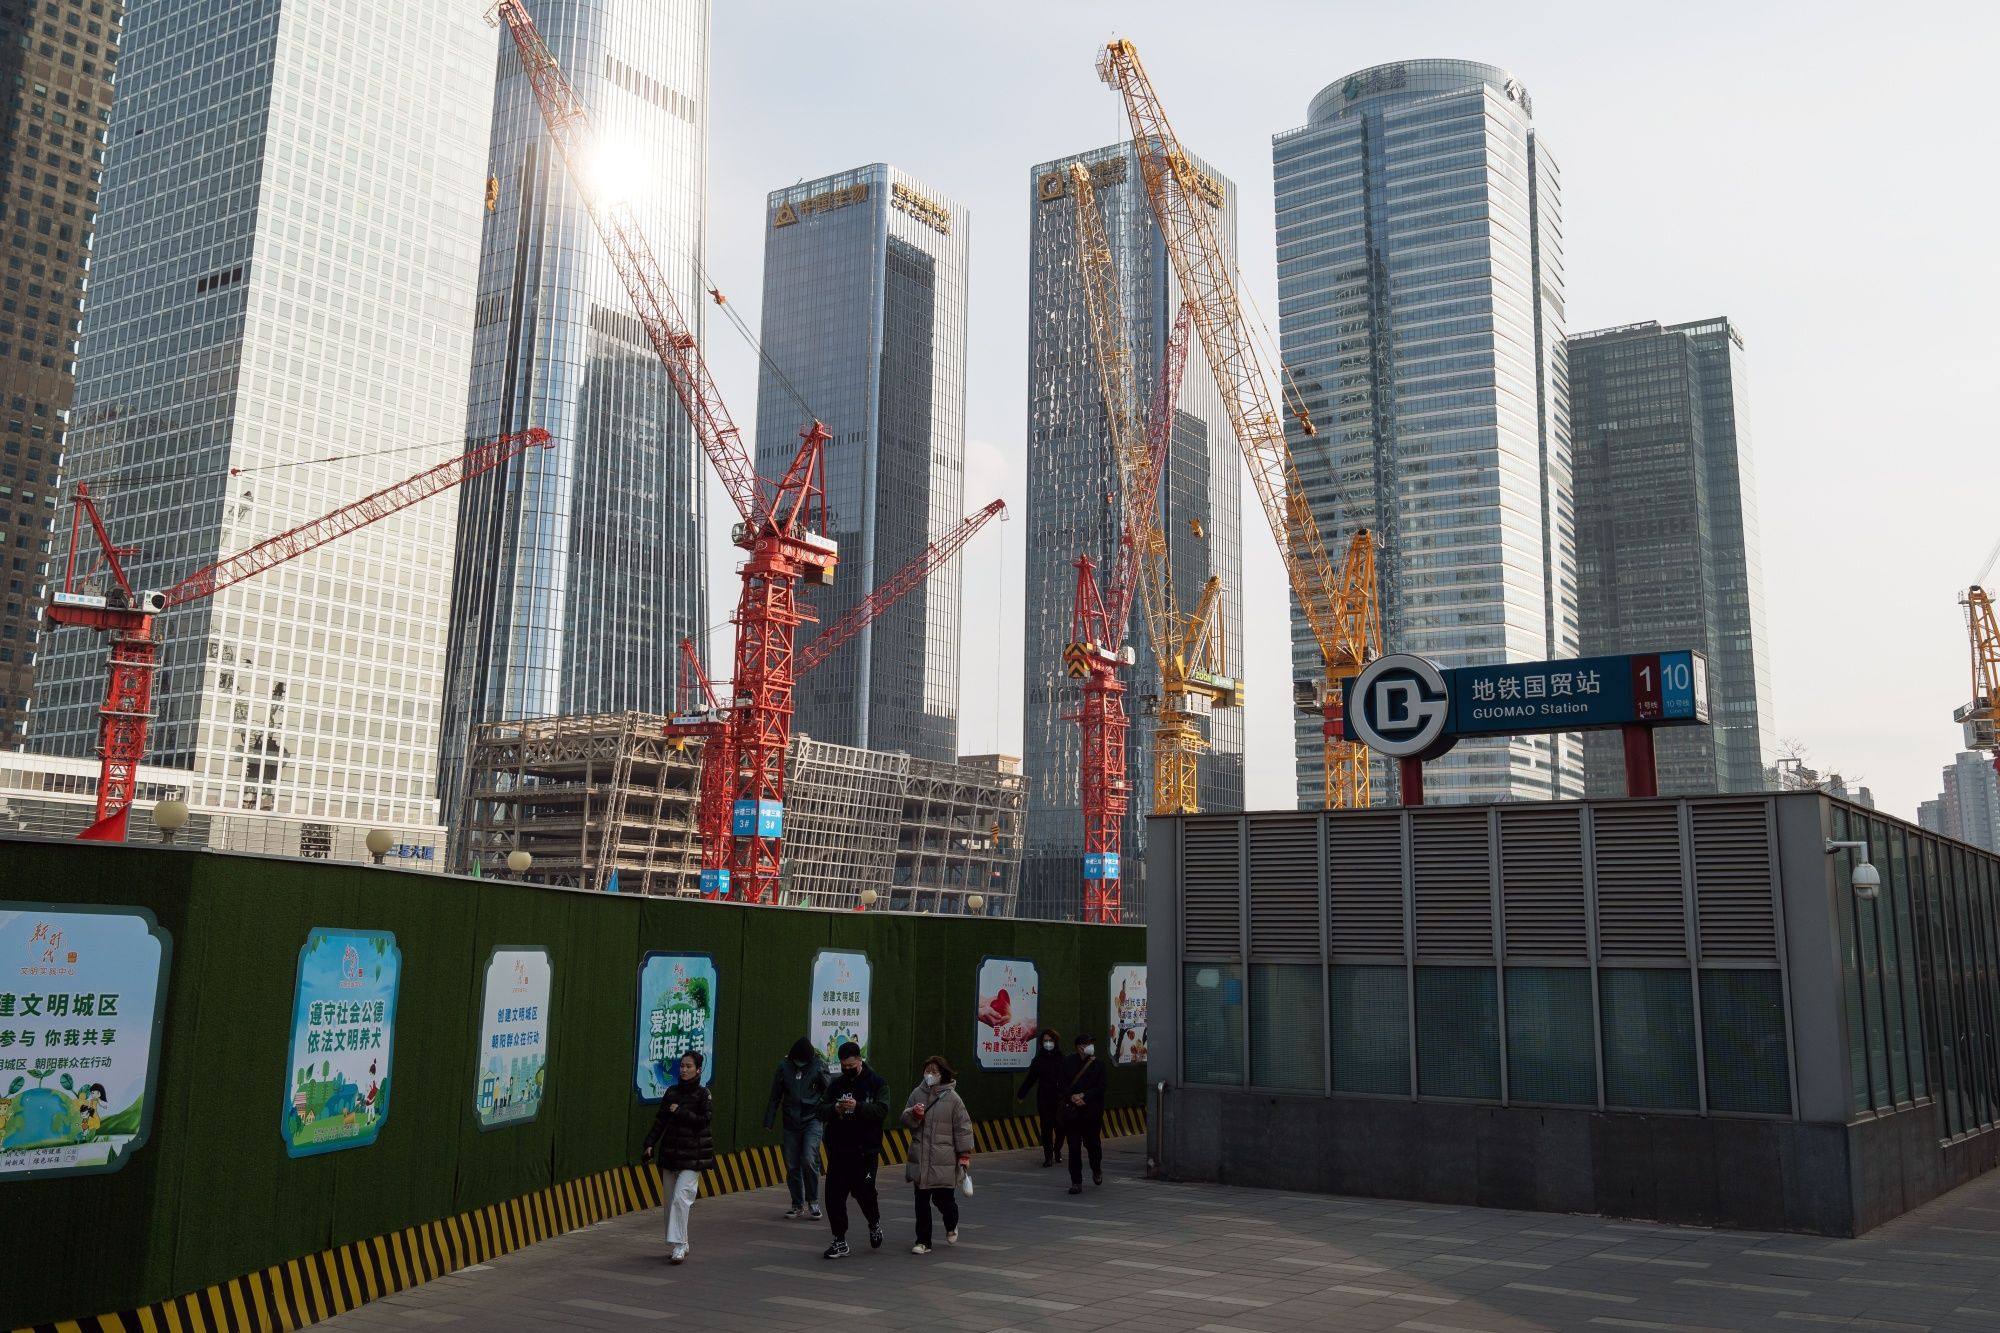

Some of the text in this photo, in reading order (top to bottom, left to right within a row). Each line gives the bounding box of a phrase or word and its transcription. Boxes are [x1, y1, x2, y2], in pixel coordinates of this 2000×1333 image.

[1472, 670, 1601, 702] 地铁国贸站
[1639, 665, 1652, 692] 1
[1663, 663, 1689, 690] 10
[1473, 702, 1588, 720] GUOMAO Station
[740, 819, 750, 828] 3#
[822, 990, 861, 1003] 创建文明城区
[309, 1001, 384, 1026] 遵守社会公德
[497, 1006, 538, 1023] 创建文明城区
[650, 1008, 706, 1035] 爱护地球
[0, 1028, 117, 1048] 参与 你我共享
[307, 1027, 382, 1054] 依法文明养犬
[491, 1031, 540, 1049] 朝阳群众在行动
[649, 1034, 705, 1062] 低碳生活
[35, 1056, 112, 1070] 朝阳群众在行动
